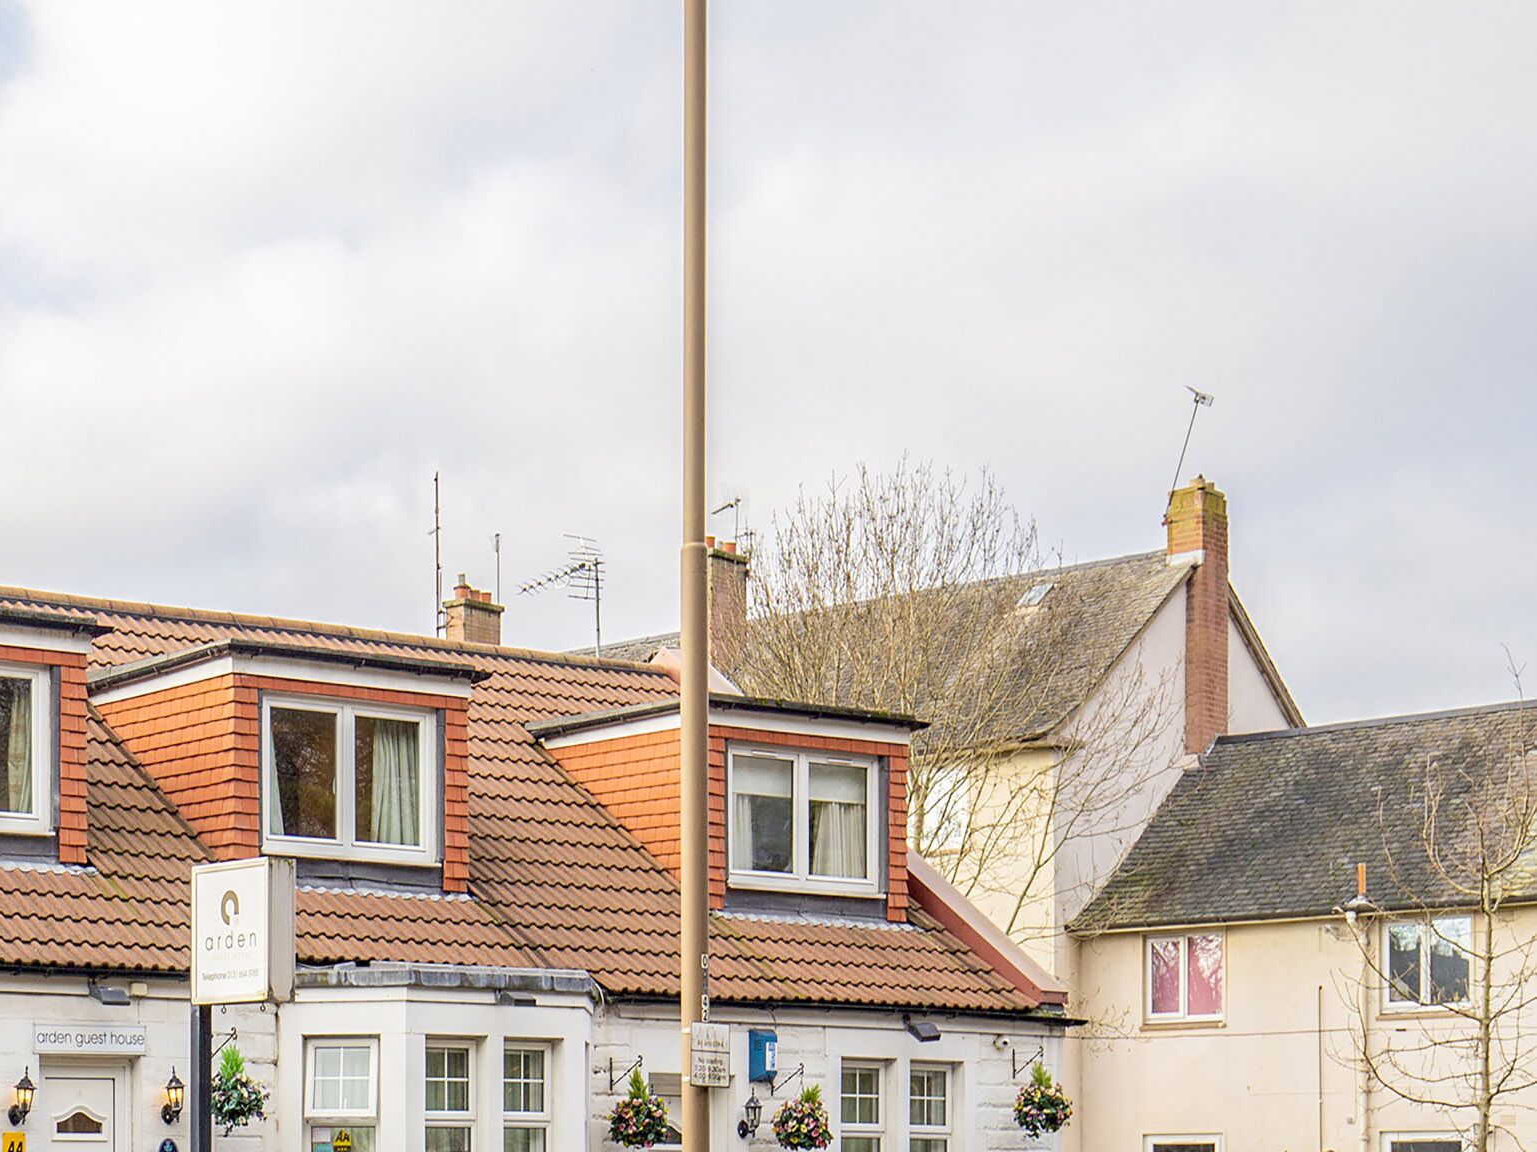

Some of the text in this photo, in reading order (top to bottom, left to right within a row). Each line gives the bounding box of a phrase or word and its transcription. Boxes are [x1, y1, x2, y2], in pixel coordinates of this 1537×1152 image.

[205, 930, 257, 951] arden
[36, 1031, 145, 1048] arden guest house
[335, 1130, 350, 1142] AA
